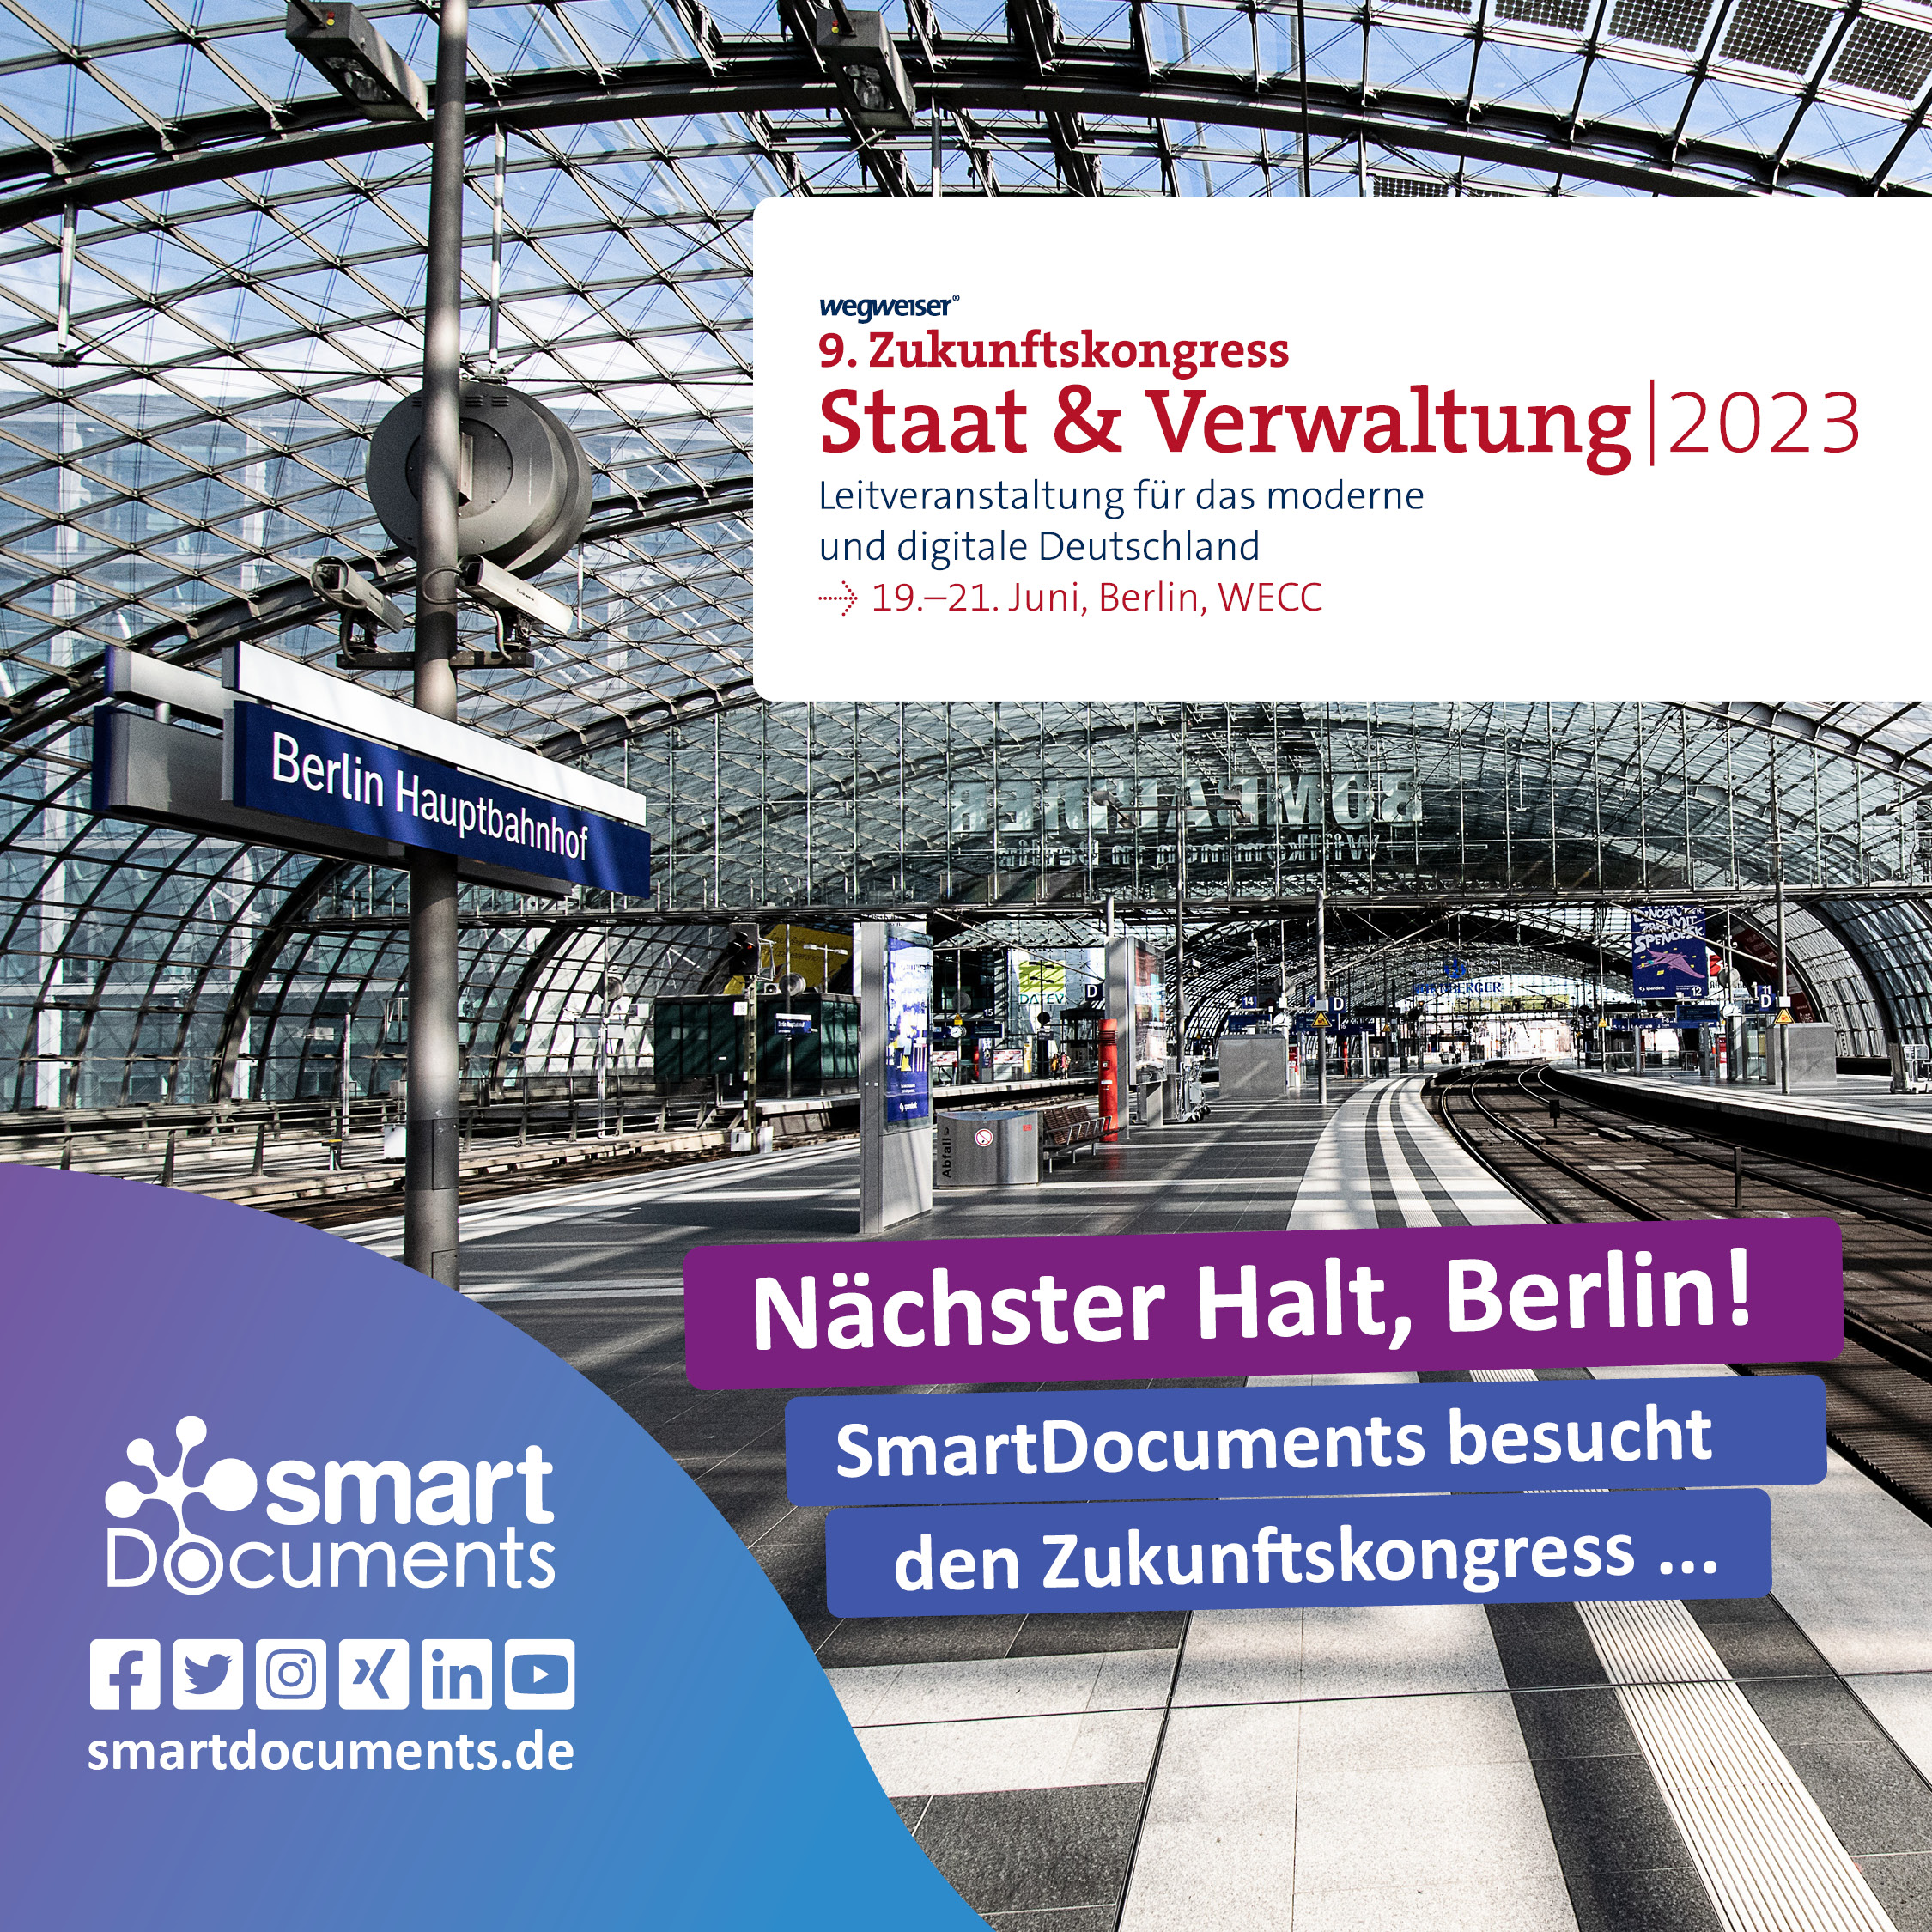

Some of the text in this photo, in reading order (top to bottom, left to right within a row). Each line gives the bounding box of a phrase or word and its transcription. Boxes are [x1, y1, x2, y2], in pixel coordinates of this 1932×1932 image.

[273, 732, 588, 860] Berlin Hauptbahnhof
[1087, 985, 1097, 998] D
[1691, 987, 1702, 996] 12
[1762, 985, 1771, 994] 11
[1243, 997, 1254, 1006] 14
[1334, 998, 1344, 1011] D
[1760, 994, 1771, 1008] D
[984, 1008, 993, 1017] 15
[942, 1139, 951, 1178] Abfall
